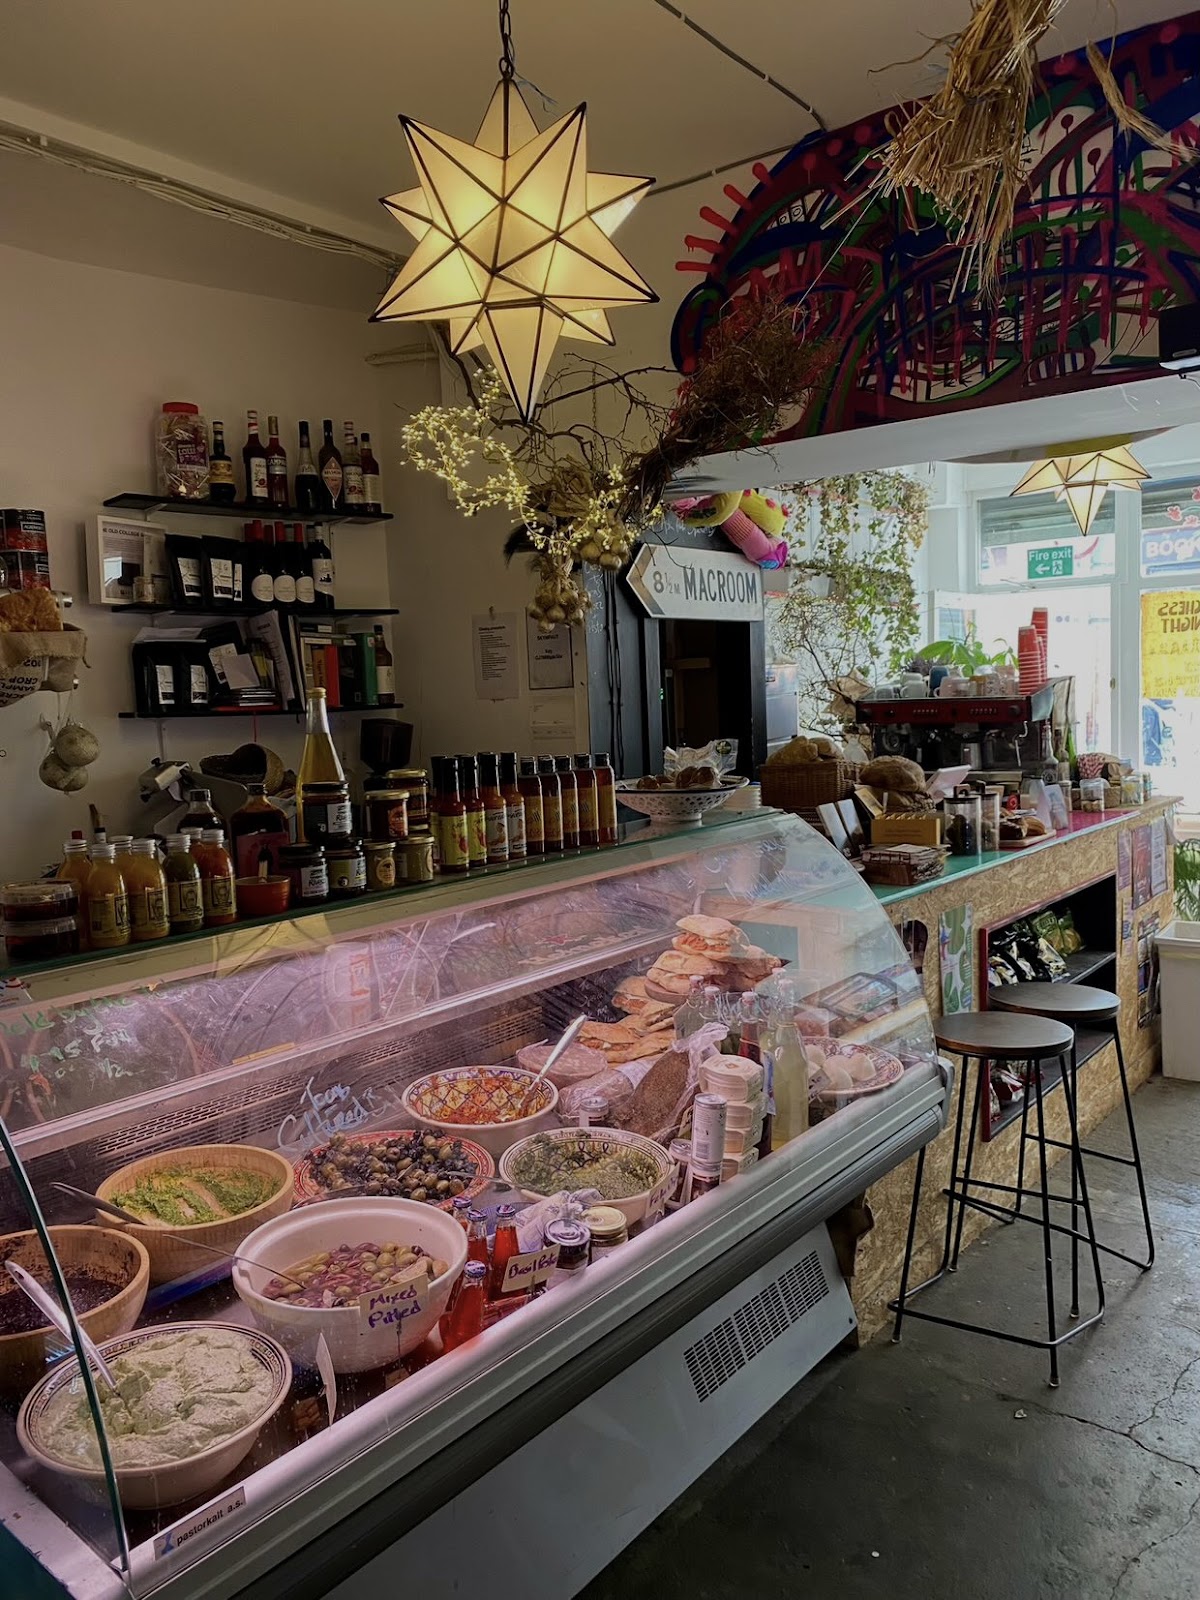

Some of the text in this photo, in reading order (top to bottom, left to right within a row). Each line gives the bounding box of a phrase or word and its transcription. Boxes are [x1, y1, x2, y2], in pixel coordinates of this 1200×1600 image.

[1028, 548, 1072, 561] Fire exit
[683, 566, 758, 604] MACROOM
[9, 676, 38, 685] CROP
[370, 1284, 418, 1310] Mixed
[368, 1300, 422, 1328] Pitted
[176, 1500, 244, 1546] pastorkalt a.s.
